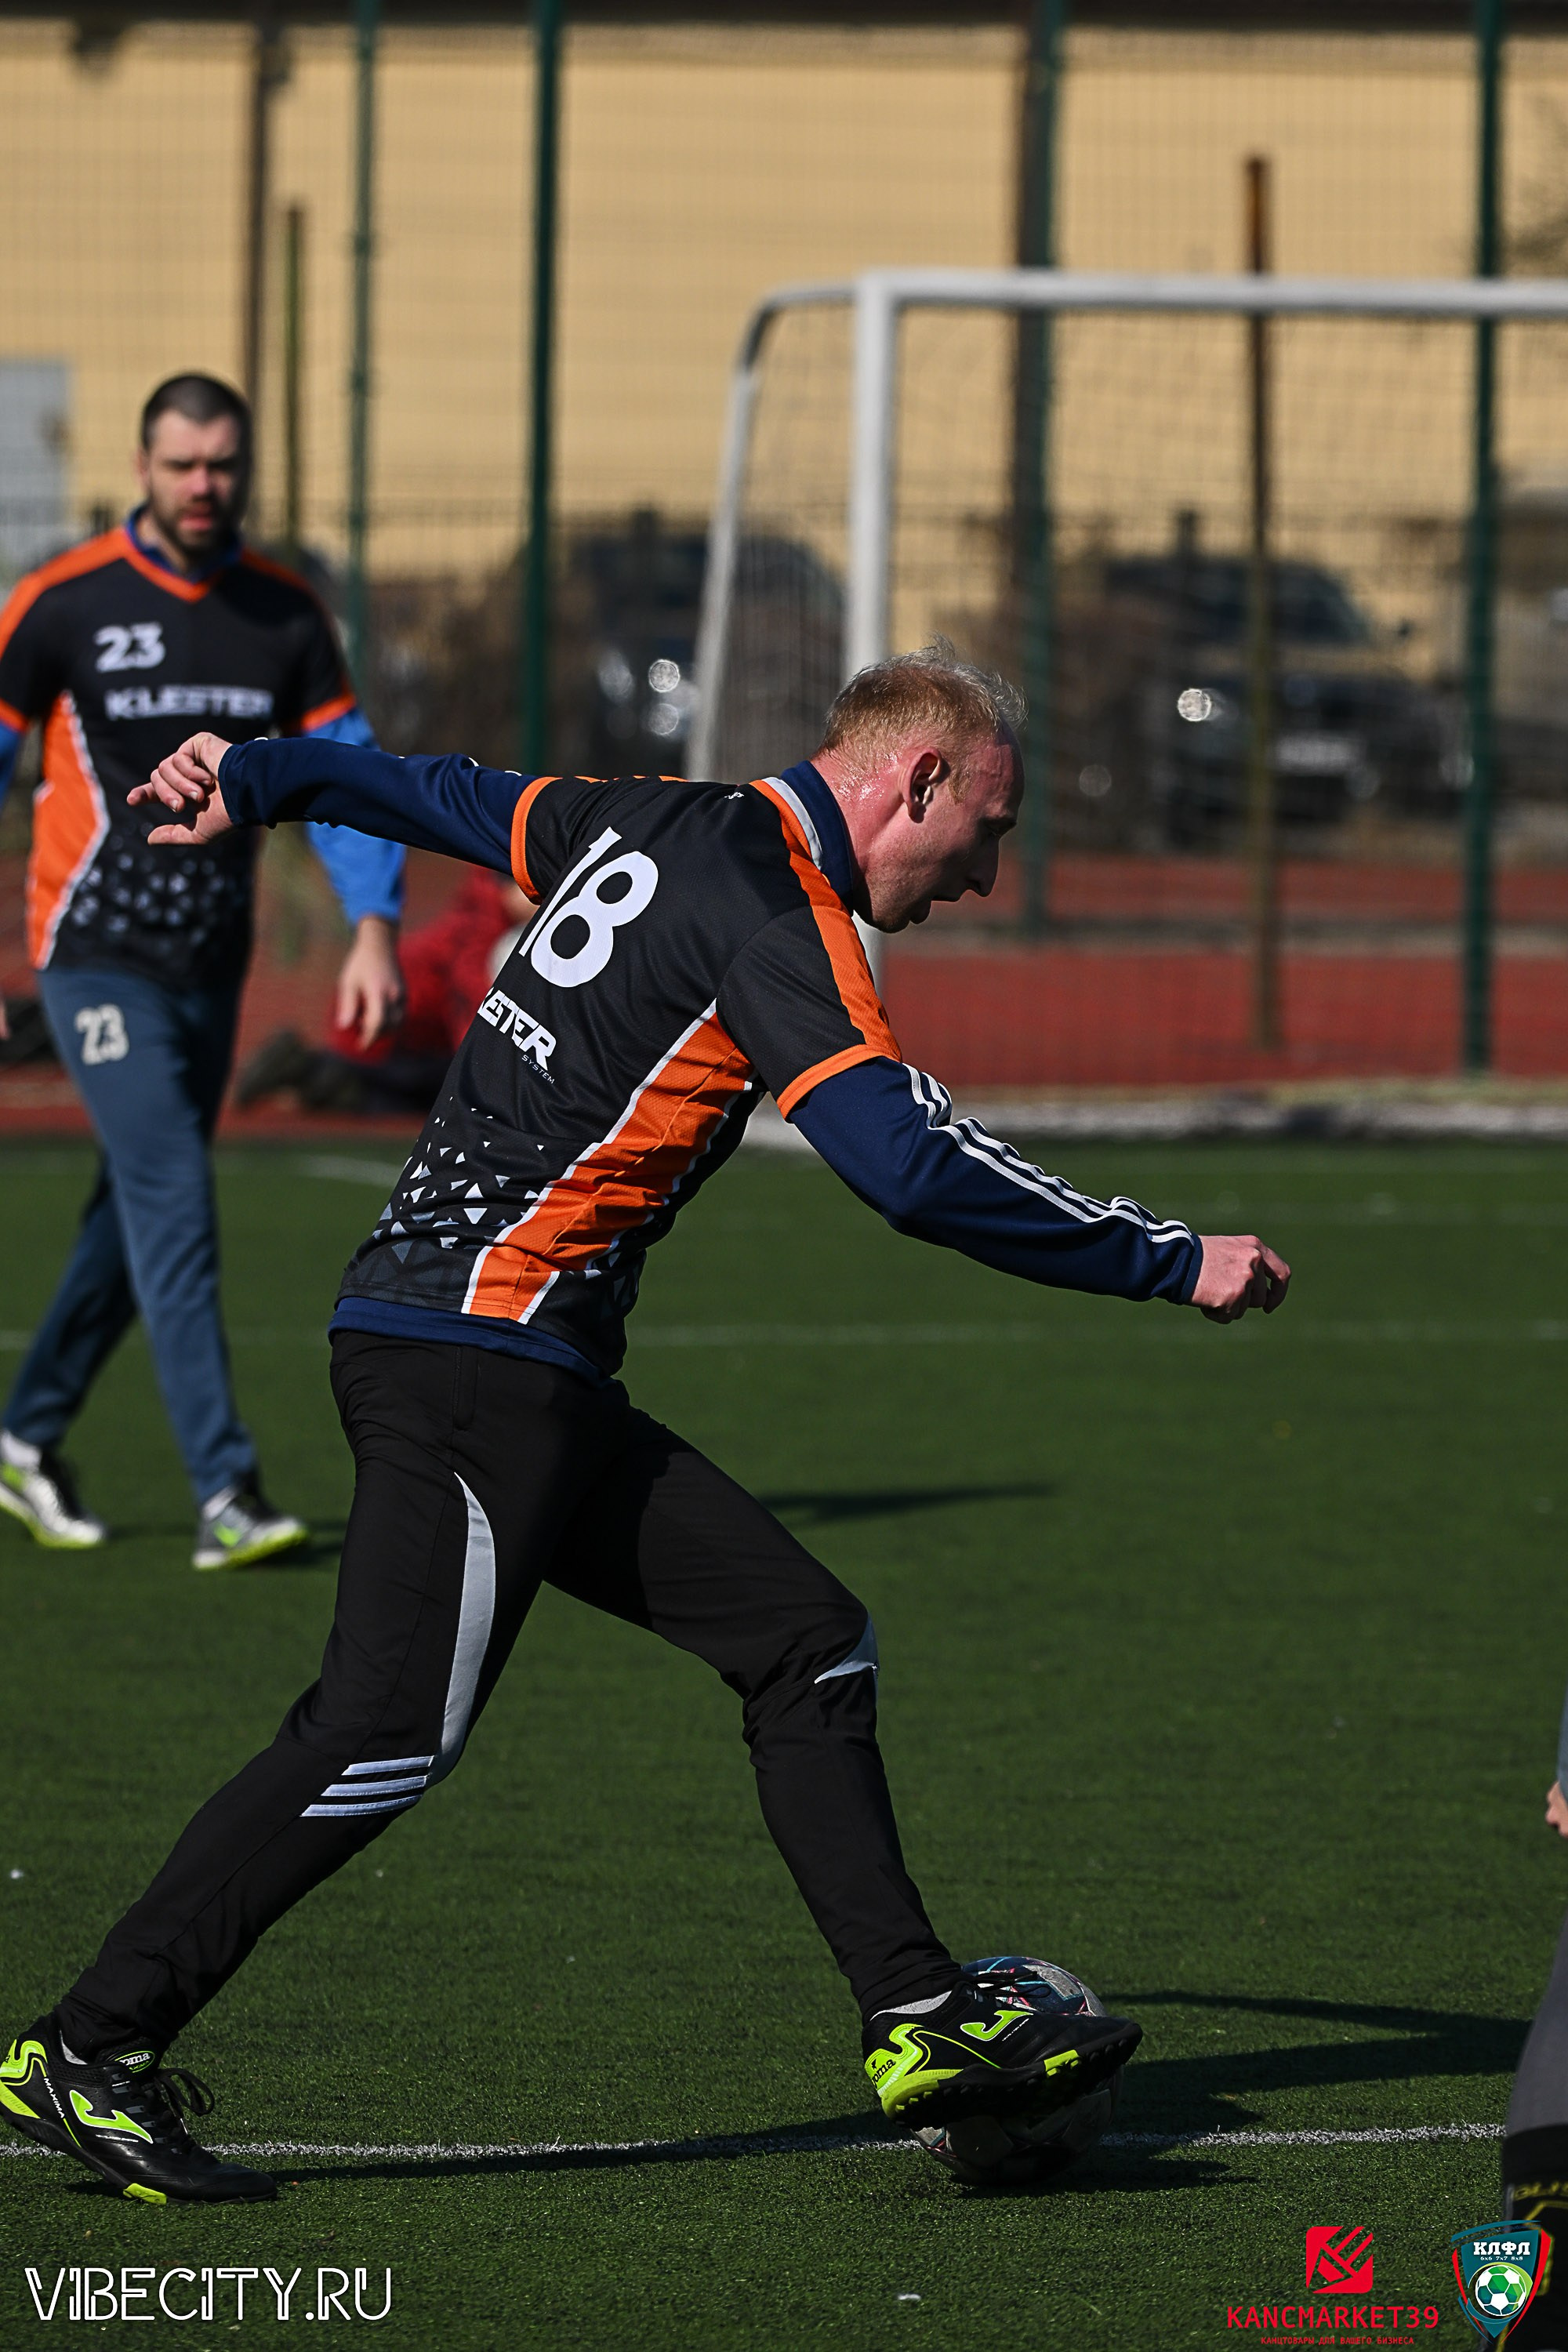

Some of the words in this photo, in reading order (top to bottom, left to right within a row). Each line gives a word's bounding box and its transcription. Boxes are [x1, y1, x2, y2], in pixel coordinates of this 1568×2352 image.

[93, 622, 166, 673] 23
[104, 684, 274, 720] KLESTER
[518, 826, 659, 988] 18
[74, 1003, 130, 1065] 23
[521, 1054, 555, 1084] SYSTEM
